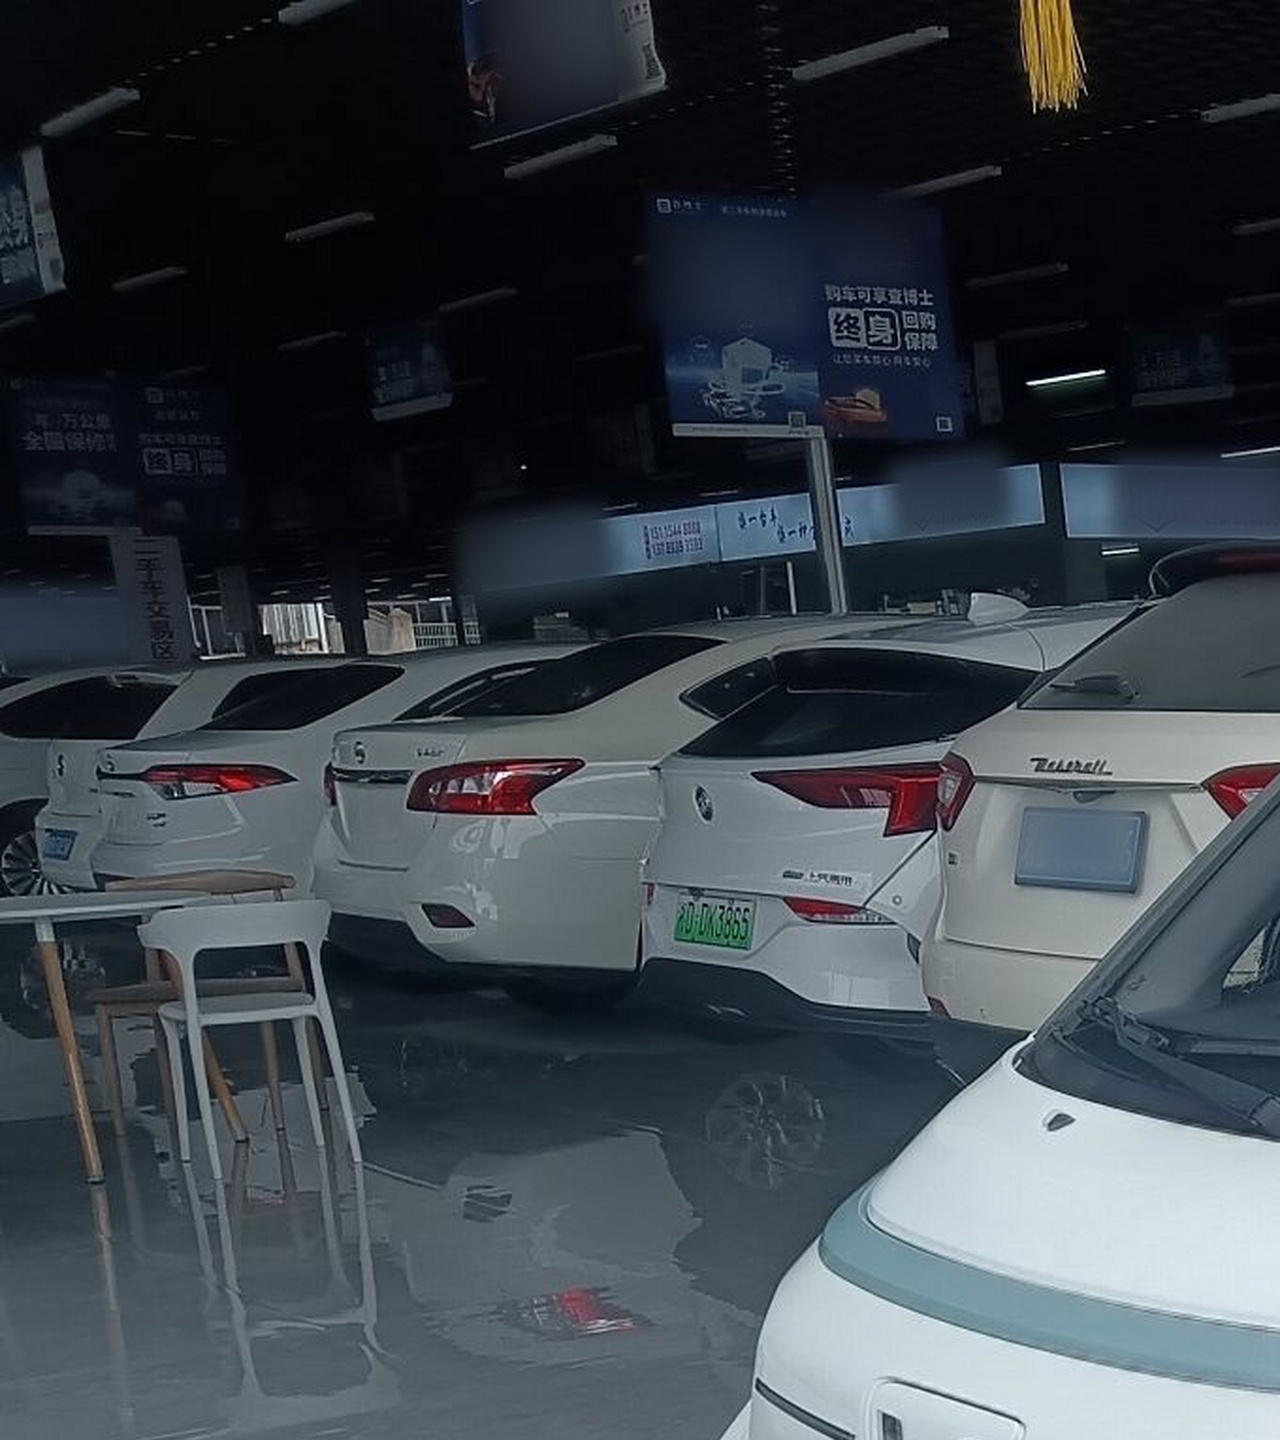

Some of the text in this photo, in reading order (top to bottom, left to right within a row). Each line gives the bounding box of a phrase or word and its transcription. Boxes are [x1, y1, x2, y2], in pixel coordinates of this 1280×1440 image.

[824, 284, 934, 306] 购车可享查博士
[830, 310, 937, 347] 终身 回购
